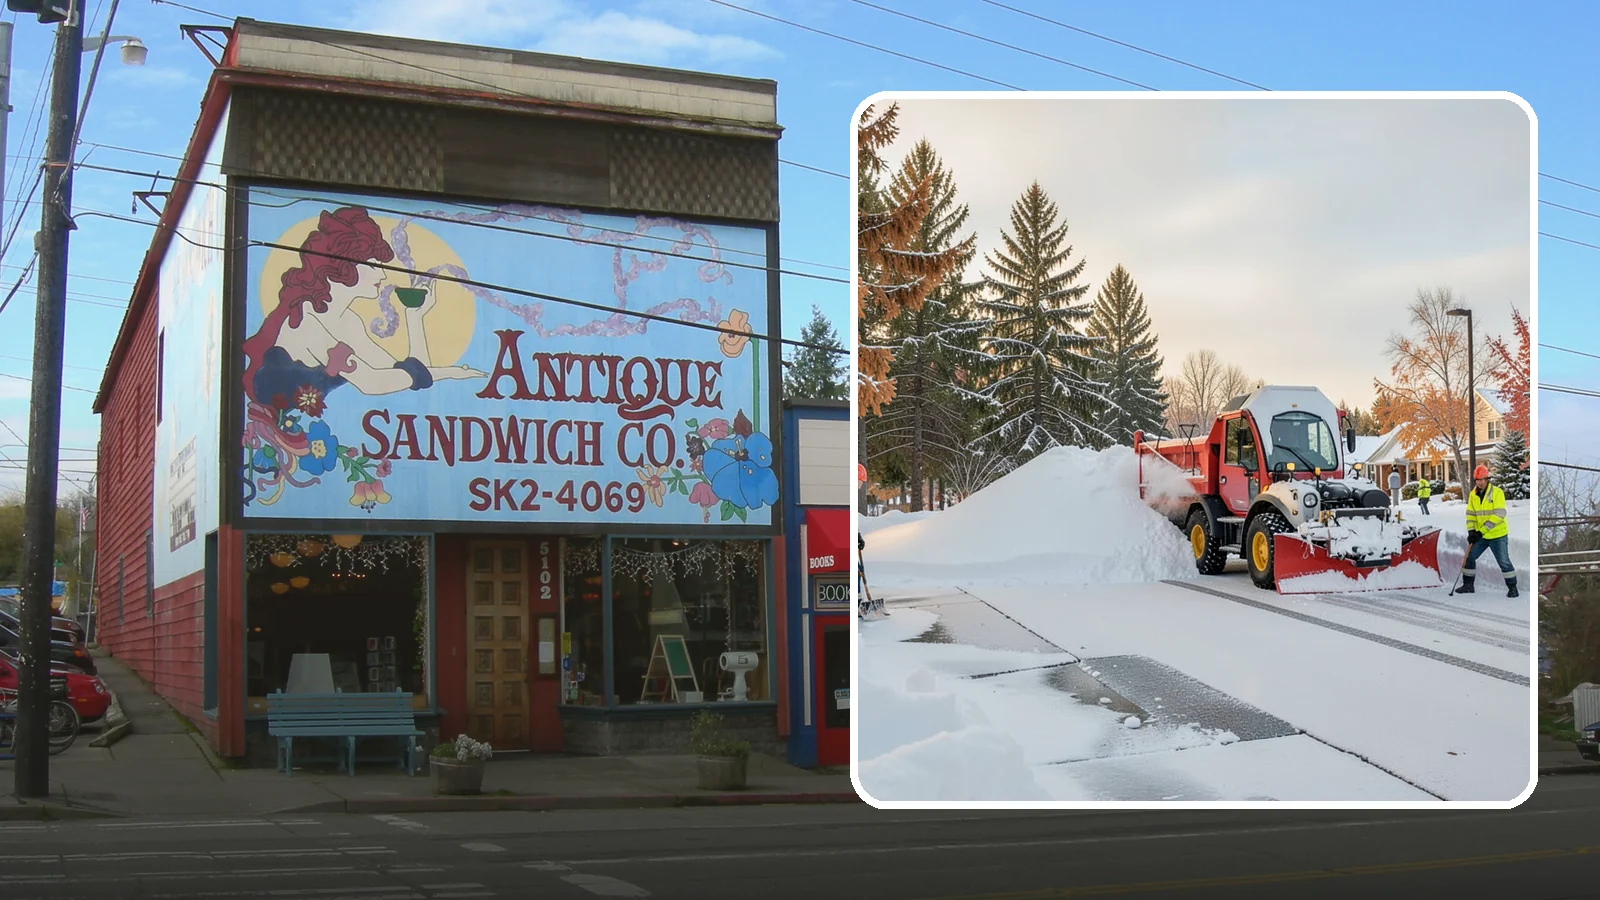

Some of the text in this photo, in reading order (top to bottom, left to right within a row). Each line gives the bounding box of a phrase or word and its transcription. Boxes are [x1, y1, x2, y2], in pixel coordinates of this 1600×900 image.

[476, 329, 724, 421] ANTIQUE
[361, 408, 685, 469] SANDWICH CO.
[468, 477, 646, 513] SK2-4069
[540, 541, 552, 599] 5102
[809, 555, 835, 569] BOOKS
